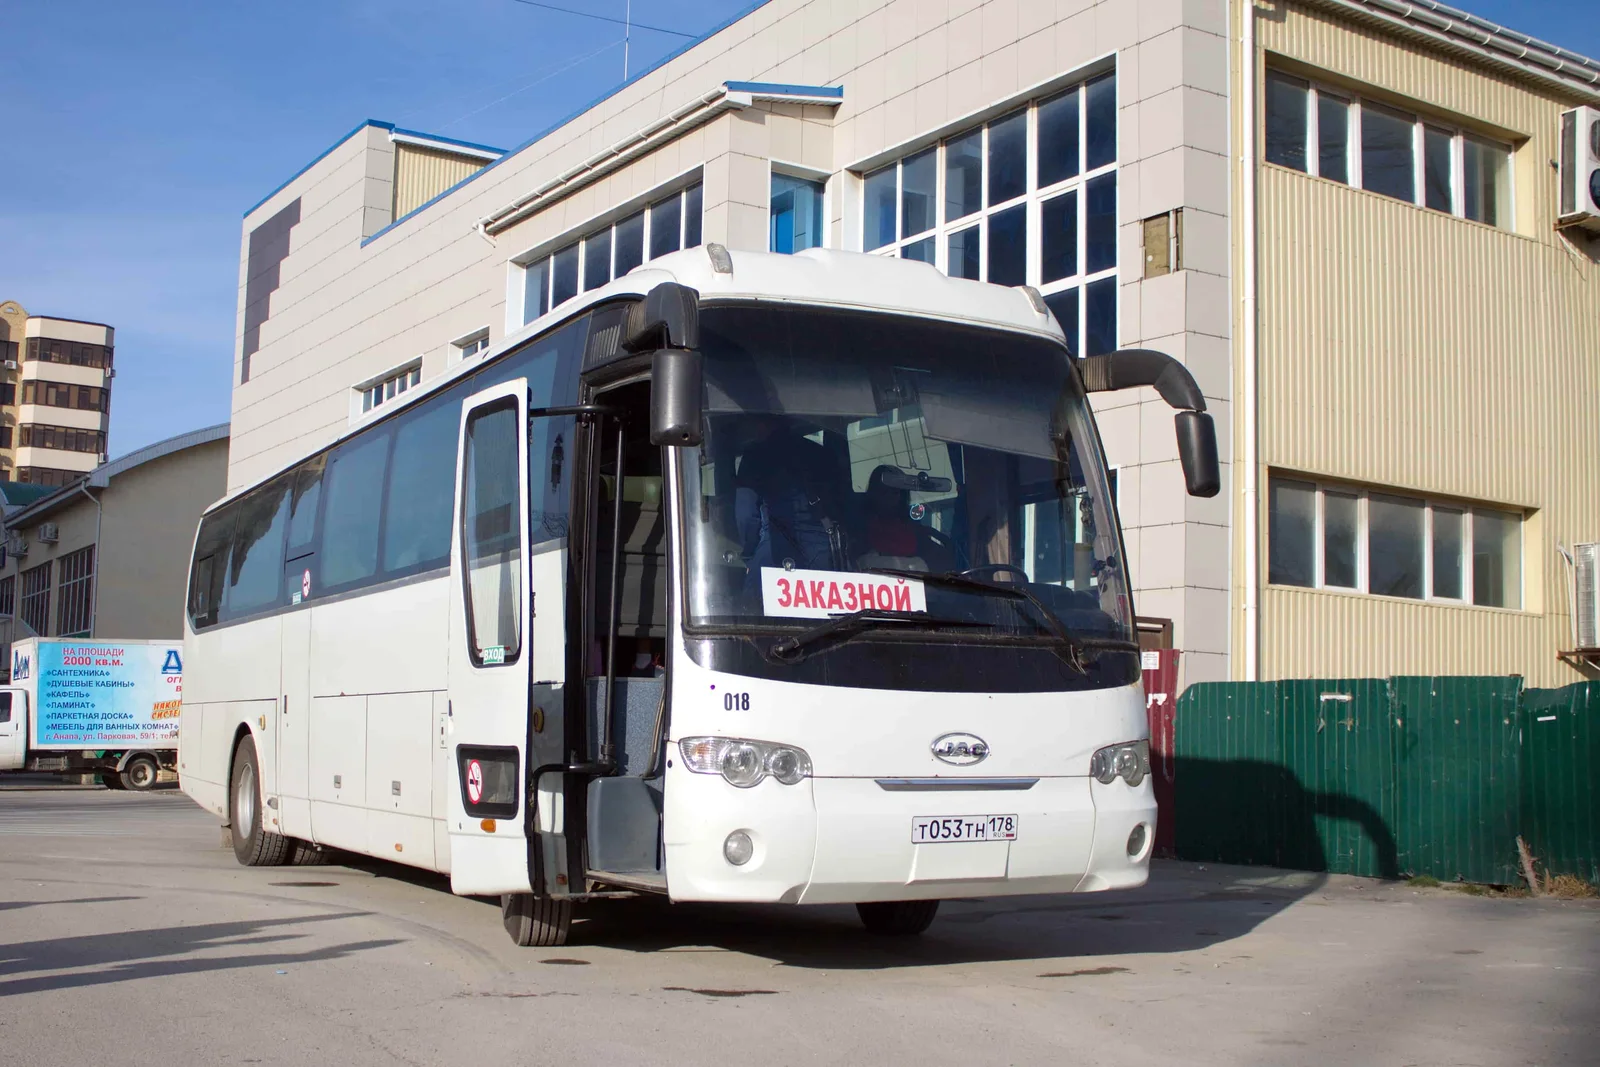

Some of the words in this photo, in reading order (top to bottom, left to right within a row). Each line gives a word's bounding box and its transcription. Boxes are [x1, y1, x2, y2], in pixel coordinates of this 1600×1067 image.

[776, 577, 912, 612] ЗАКАЗНОЙ
[78, 648, 124, 657] ПЛОЩАДИ
[484, 647, 504, 662] ВХОД
[63, 656, 91, 666] 2000
[95, 658, 124, 666] кв.м.
[51, 669, 106, 677] САНТЕХНИКА
[51, 680, 94, 688] ДУШЕВЫЕ
[51, 701, 91, 709] ЛАМИНАТ
[724, 692, 750, 711] 018
[51, 712, 100, 720] ПАРКЕТНАЯ
[101, 713, 129, 721] ДОСКА
[151, 709, 181, 719] СИСТЕ
[86, 723, 103, 731] ДЛЯ
[53, 733, 81, 741] Анапа,
[97, 733, 138, 741] Парковая,
[938, 742, 985, 758] JAC
[989, 817, 1013, 832] 178
